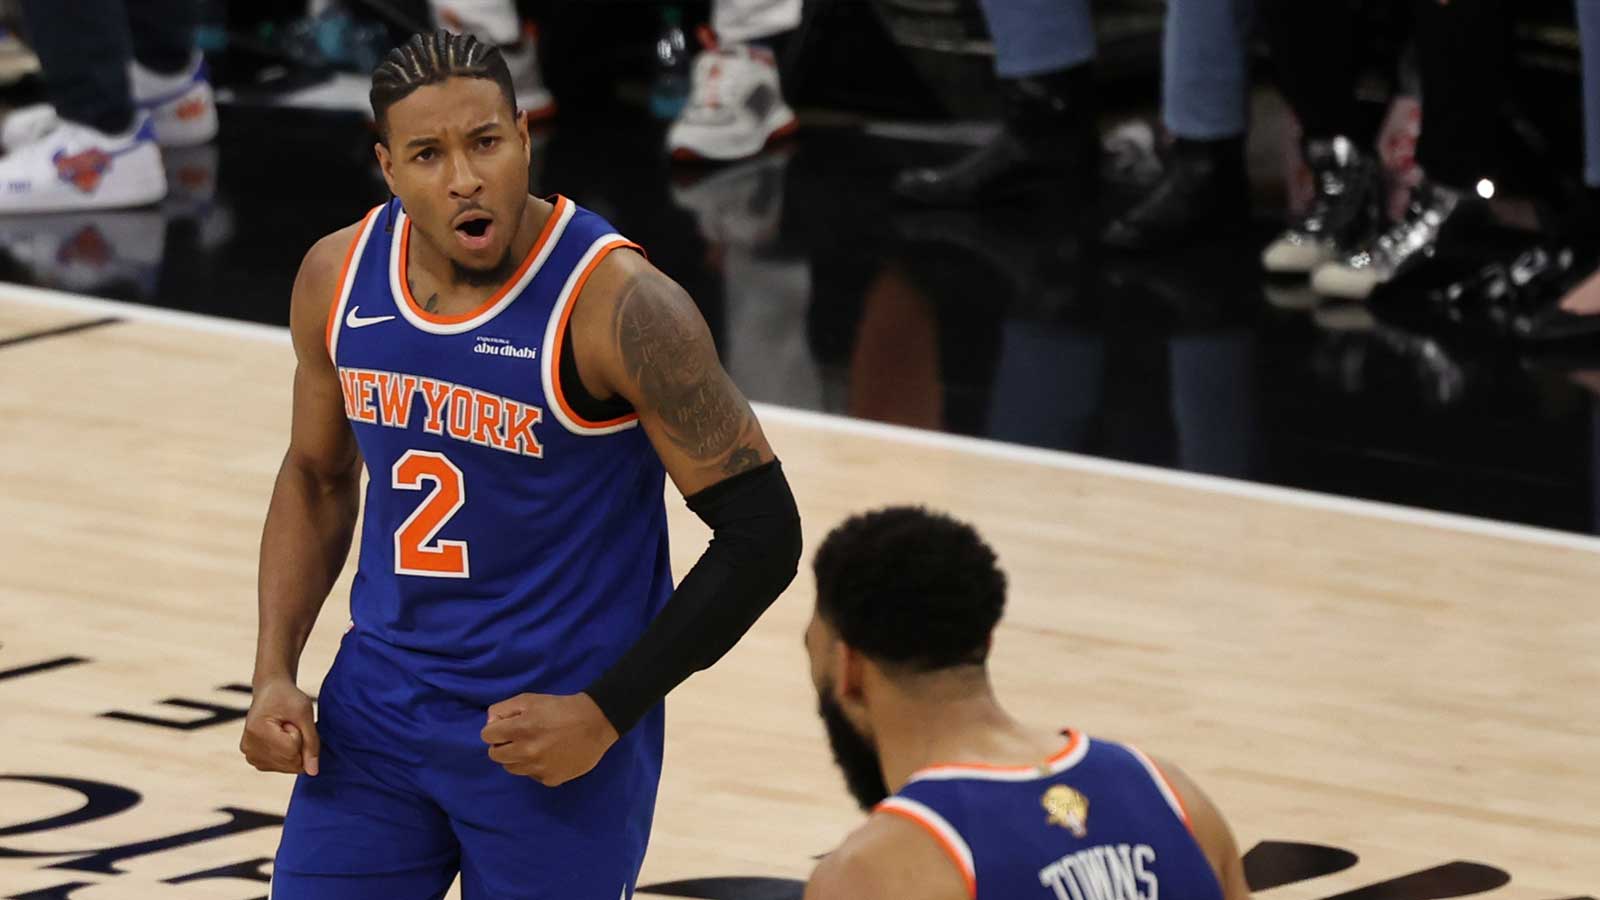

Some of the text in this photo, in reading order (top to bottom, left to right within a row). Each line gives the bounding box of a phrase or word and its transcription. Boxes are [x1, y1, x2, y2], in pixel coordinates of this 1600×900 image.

[473, 342, 537, 359] abu dhabi
[338, 366, 543, 459] NEW YORK
[392, 449, 470, 578] 2
[1038, 843, 1159, 900] TOWNS
